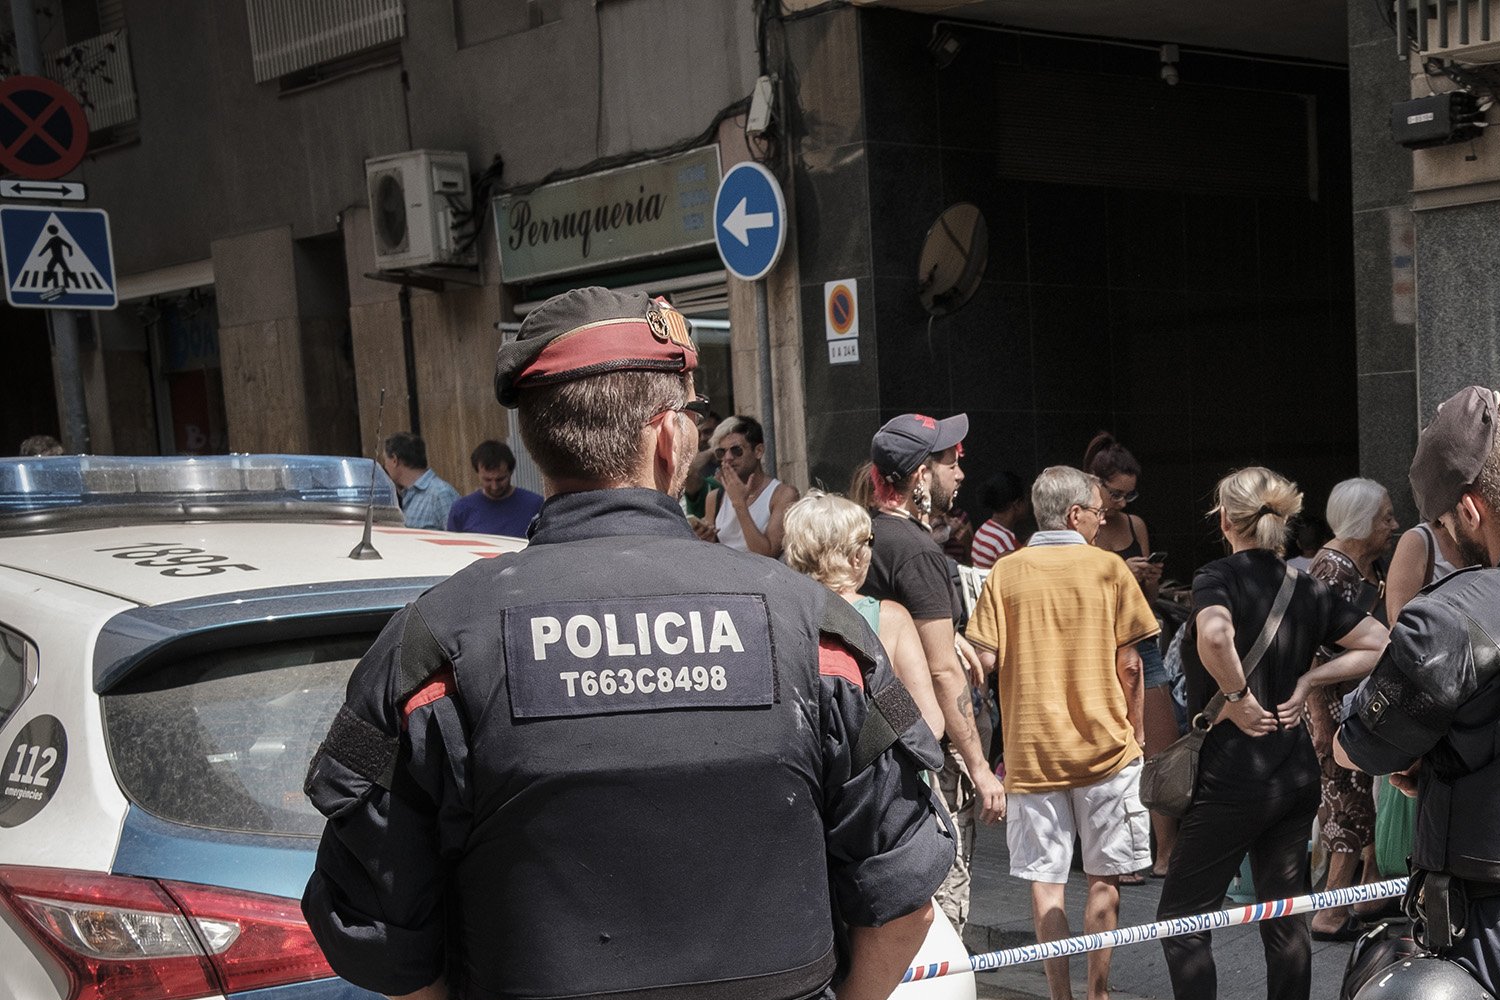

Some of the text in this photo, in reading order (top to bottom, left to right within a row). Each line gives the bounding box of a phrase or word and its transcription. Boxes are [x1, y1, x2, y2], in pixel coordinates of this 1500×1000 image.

[508, 185, 668, 258] Perruqueria
[94, 542, 259, 578] 1895
[531, 610, 744, 660] POLICIA
[560, 665, 728, 697] T663C8498
[8, 743, 58, 787] 112
[1166, 914, 1211, 936] PASSEU
[1213, 910, 1230, 926] NO
[1053, 933, 1103, 957] MOSSOS
[1111, 925, 1158, 946] POLICIA
